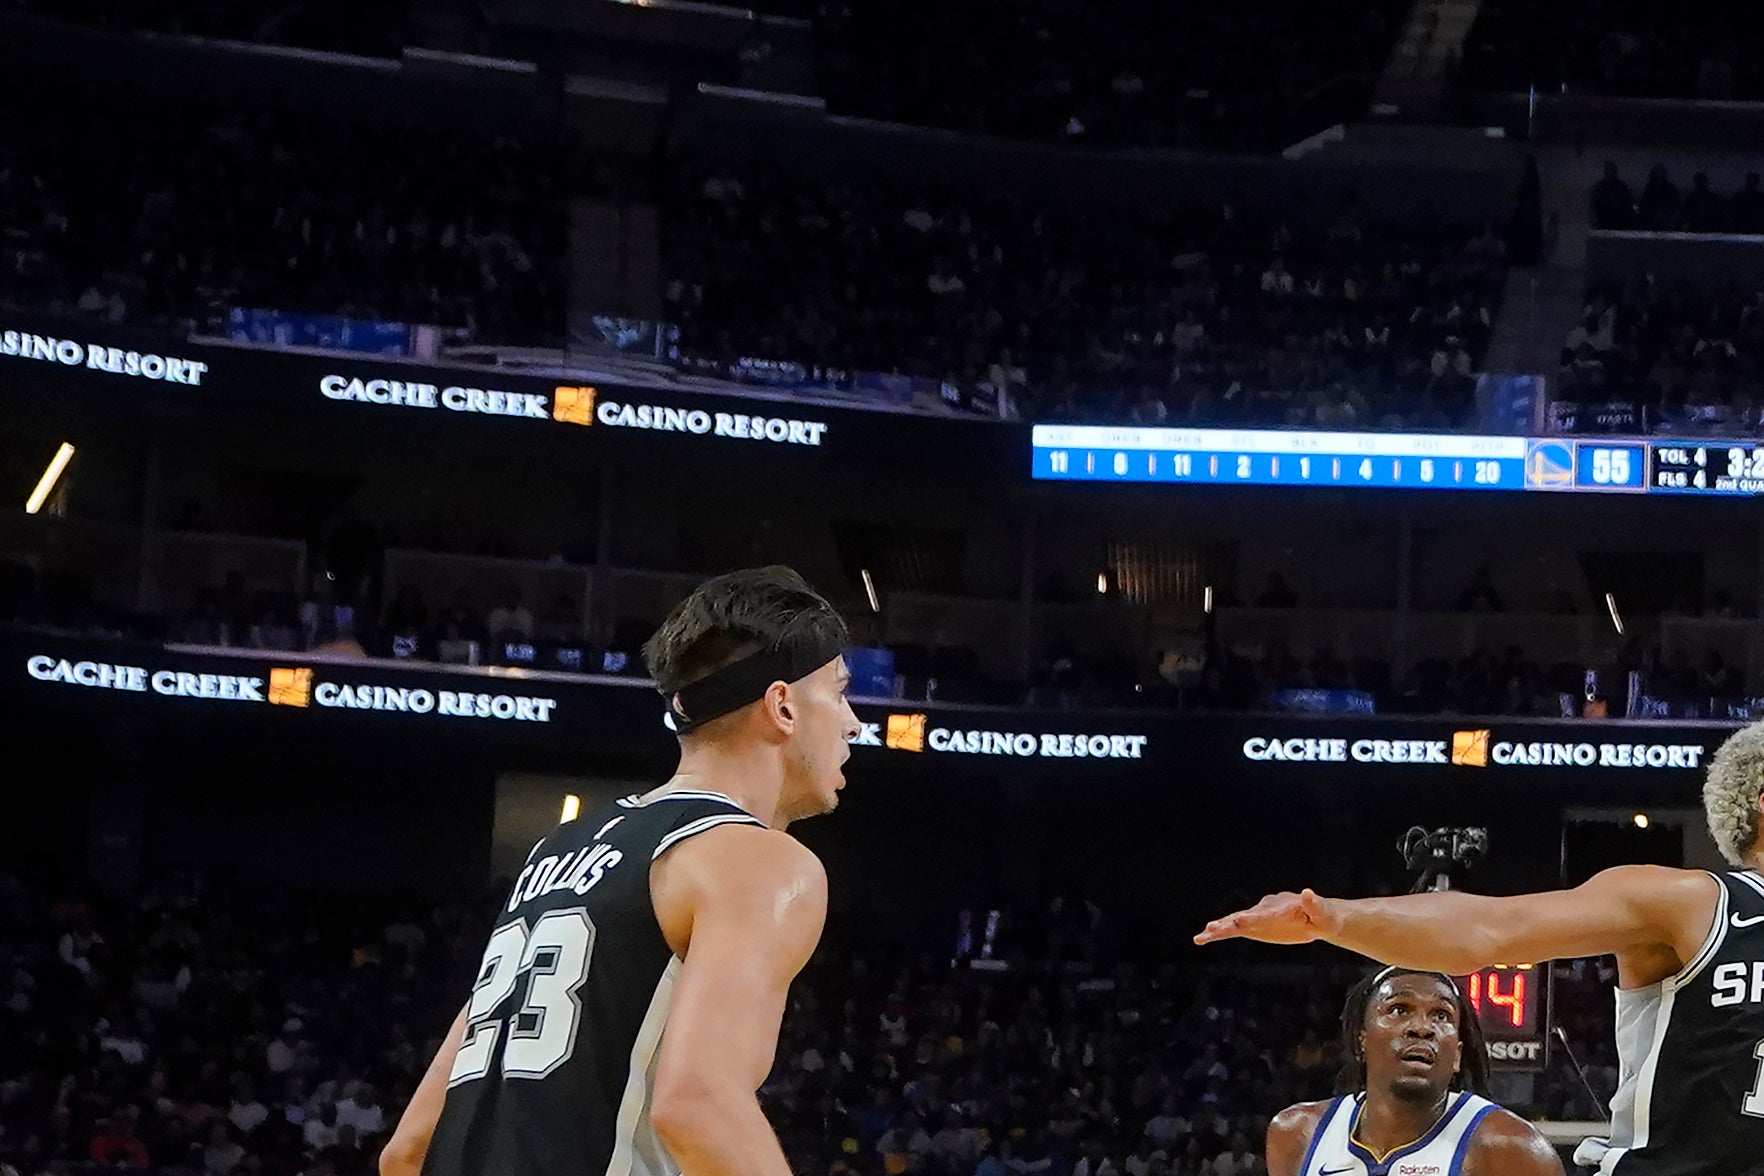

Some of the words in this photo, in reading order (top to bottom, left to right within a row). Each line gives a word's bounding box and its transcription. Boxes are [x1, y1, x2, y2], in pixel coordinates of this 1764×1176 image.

[0, 330, 84, 366] SINO
[86, 343, 208, 386] RESORT
[320, 374, 438, 408] CACHE
[442, 386, 550, 419] CREEK
[597, 401, 712, 434] CASINO
[714, 412, 828, 446] RESORT
[1050, 450, 1068, 473] 11
[1173, 454, 1191, 477] 11
[1236, 455, 1251, 478] 2
[1300, 457, 1310, 480] 1
[1359, 457, 1373, 480] 4
[1474, 461, 1500, 484] 20
[1592, 449, 1630, 484] 55
[1658, 449, 1688, 465] TOL
[1694, 447, 1707, 466] 4
[1658, 471, 1688, 488] FLS
[1693, 469, 1707, 489] 4
[27, 654, 148, 691] CACHE
[151, 670, 266, 701] CREEK
[314, 681, 434, 714] CASINO
[438, 690, 557, 722] RESORT
[928, 727, 1037, 756] CASINO
[1040, 733, 1147, 759] RESORT
[1243, 737, 1348, 762] CACHE
[1351, 739, 1449, 764] CREEK
[1492, 742, 1597, 766] CASINO
[1599, 744, 1704, 768] RESORT
[447, 906, 597, 1090] 23
[1469, 973, 1526, 1028] 14
